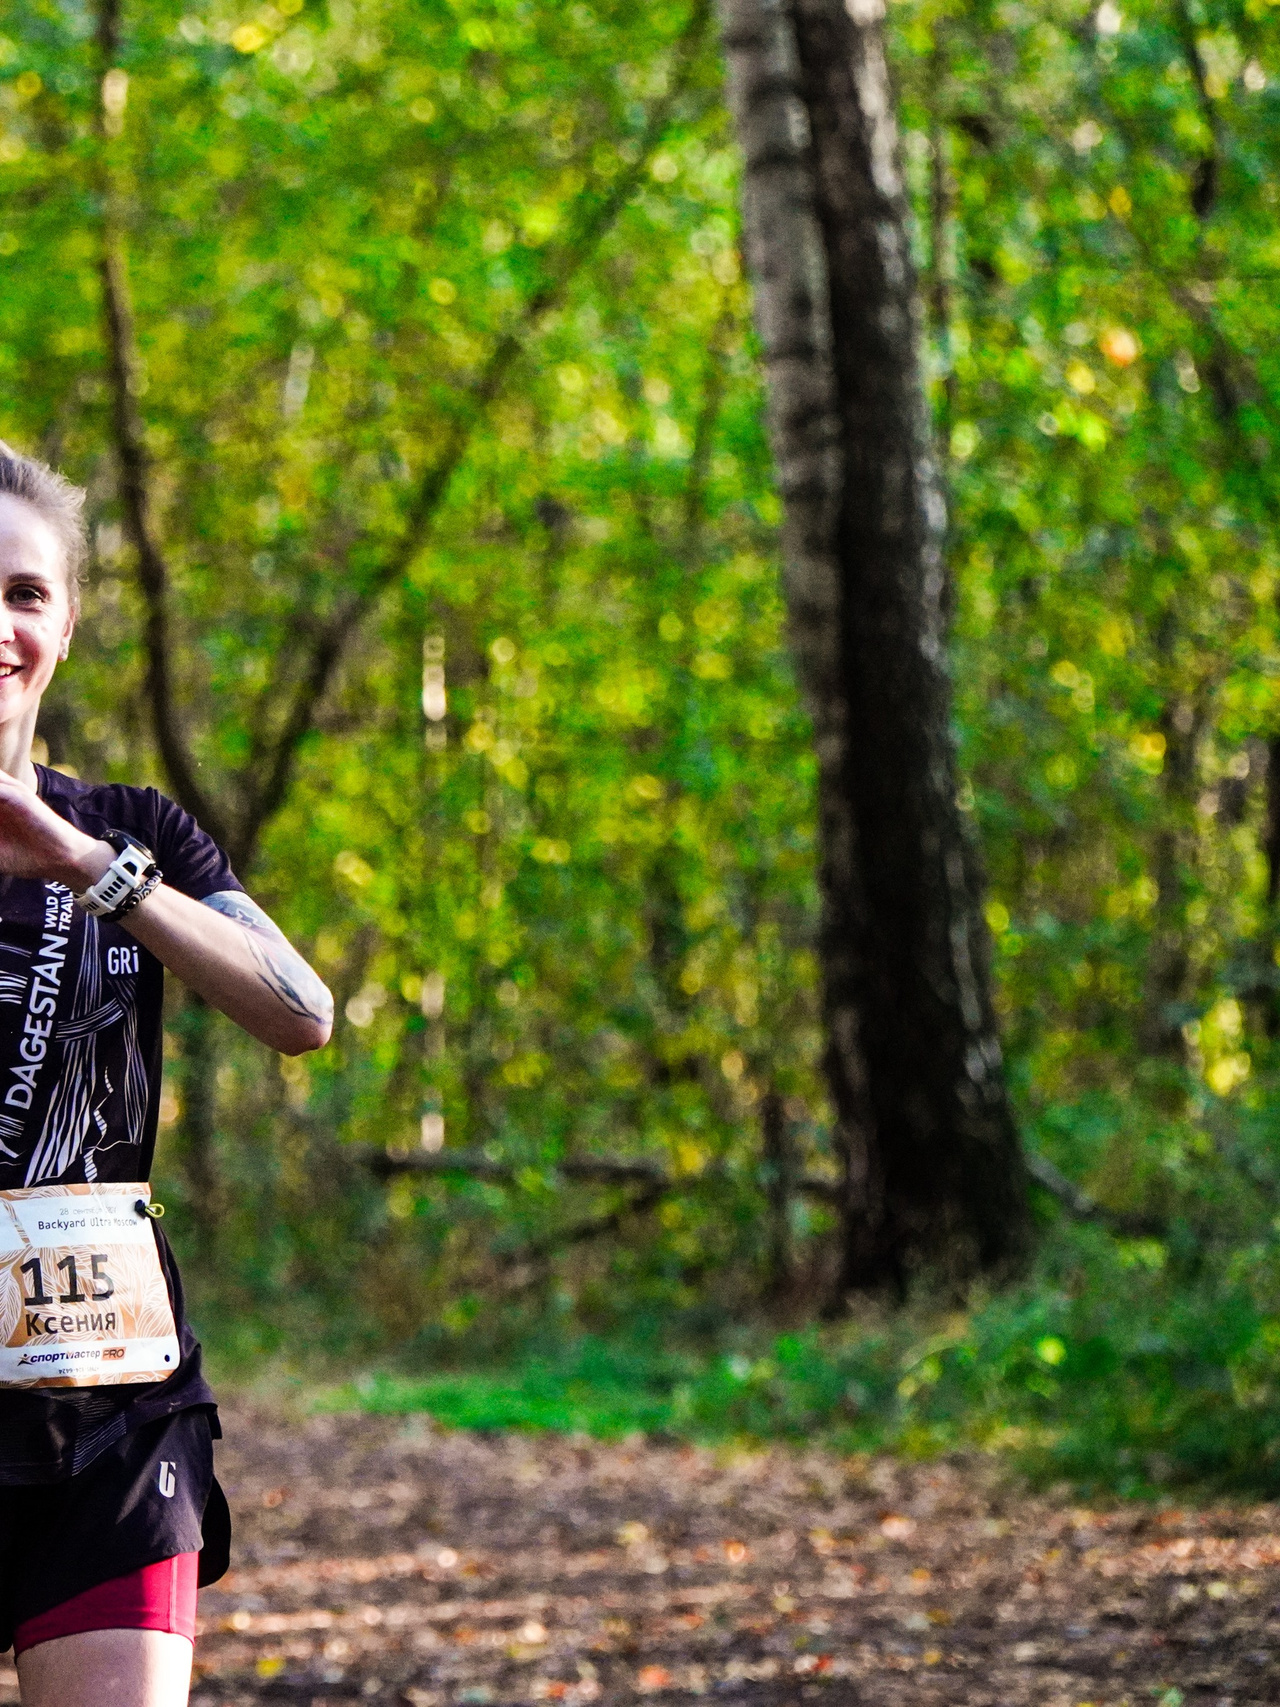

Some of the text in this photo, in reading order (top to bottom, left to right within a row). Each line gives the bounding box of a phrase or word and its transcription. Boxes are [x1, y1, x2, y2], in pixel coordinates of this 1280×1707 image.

[44, 896, 59, 928] WILD
[58, 891, 74, 932] TRAIL
[4, 933, 69, 1110] DAGESTAN
[38, 1219, 86, 1231] Backyard
[89, 1217, 111, 1227] Ultra
[20, 1254, 114, 1306] 115
[25, 1312, 115, 1336] Ксения
[103, 1348, 125, 1358] PRO
